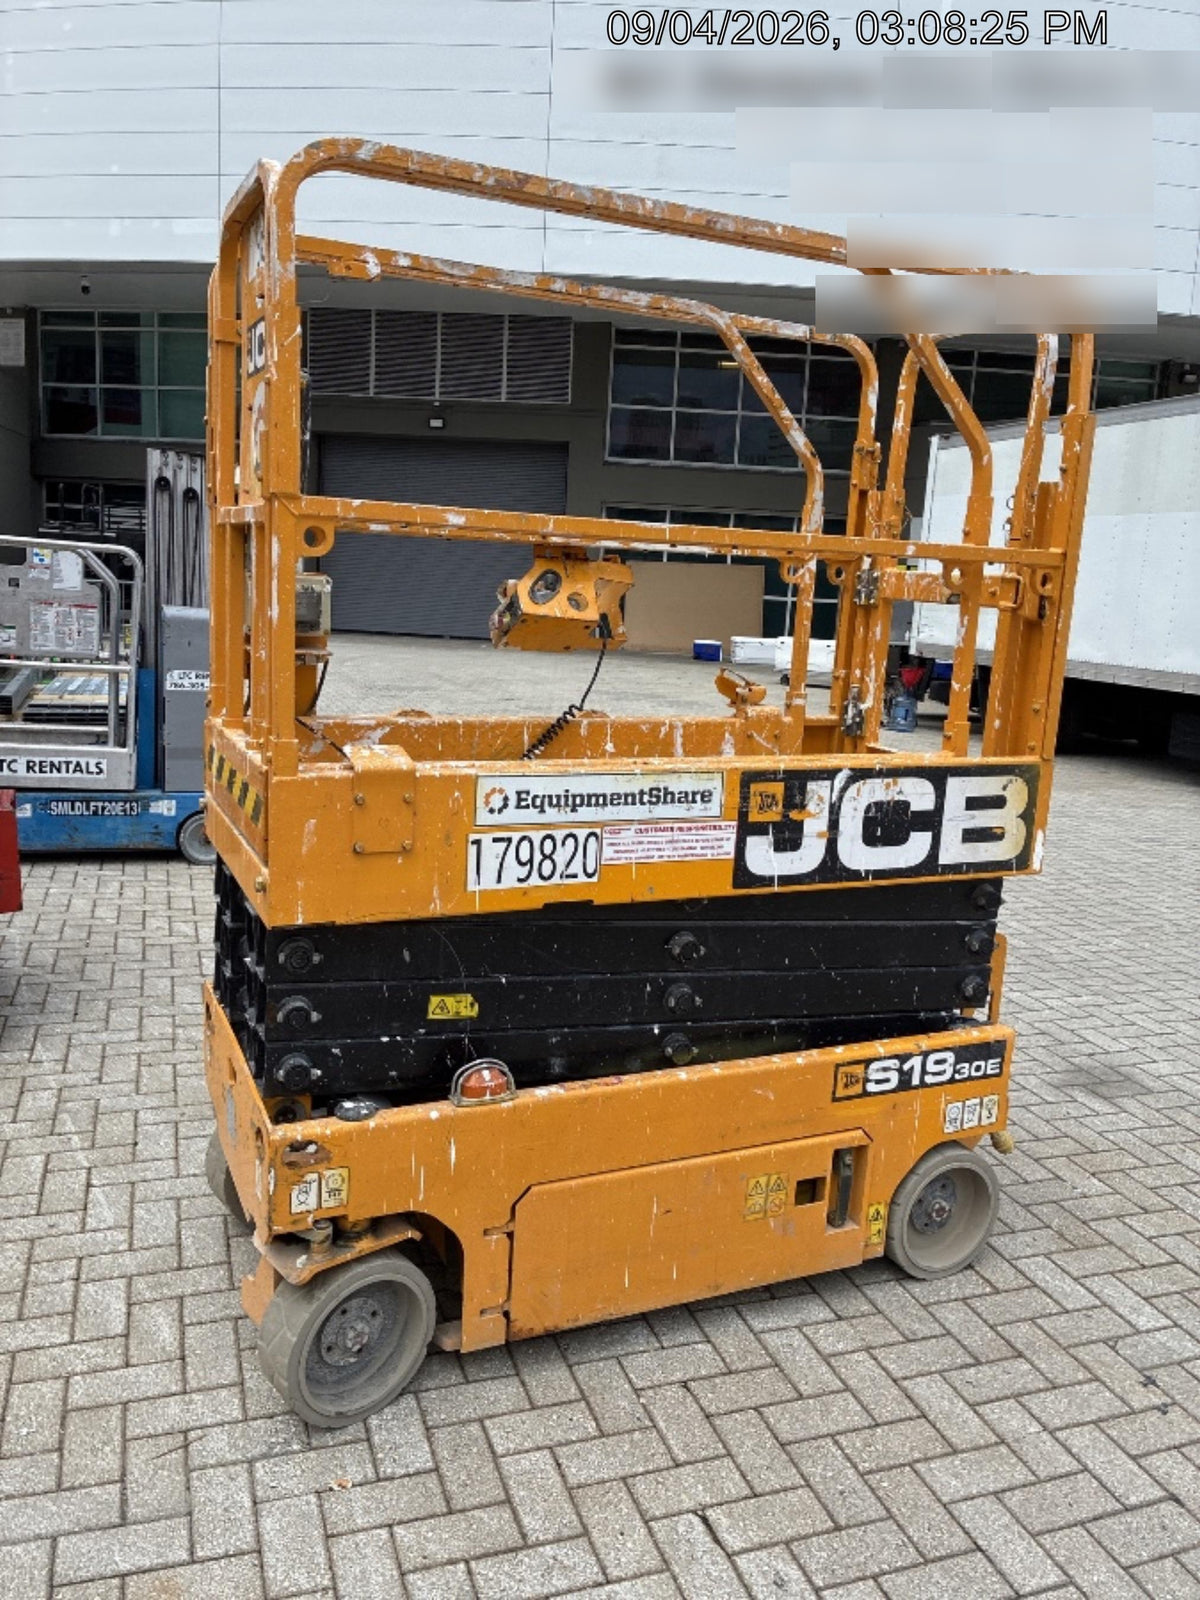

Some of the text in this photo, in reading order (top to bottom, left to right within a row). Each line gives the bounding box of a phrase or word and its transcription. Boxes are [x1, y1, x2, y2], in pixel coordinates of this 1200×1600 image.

[26, 760, 104, 775] RENTALS
[515, 786, 713, 814] EquipmentShare
[745, 775, 1029, 876] JCB
[471, 832, 599, 886] 179820
